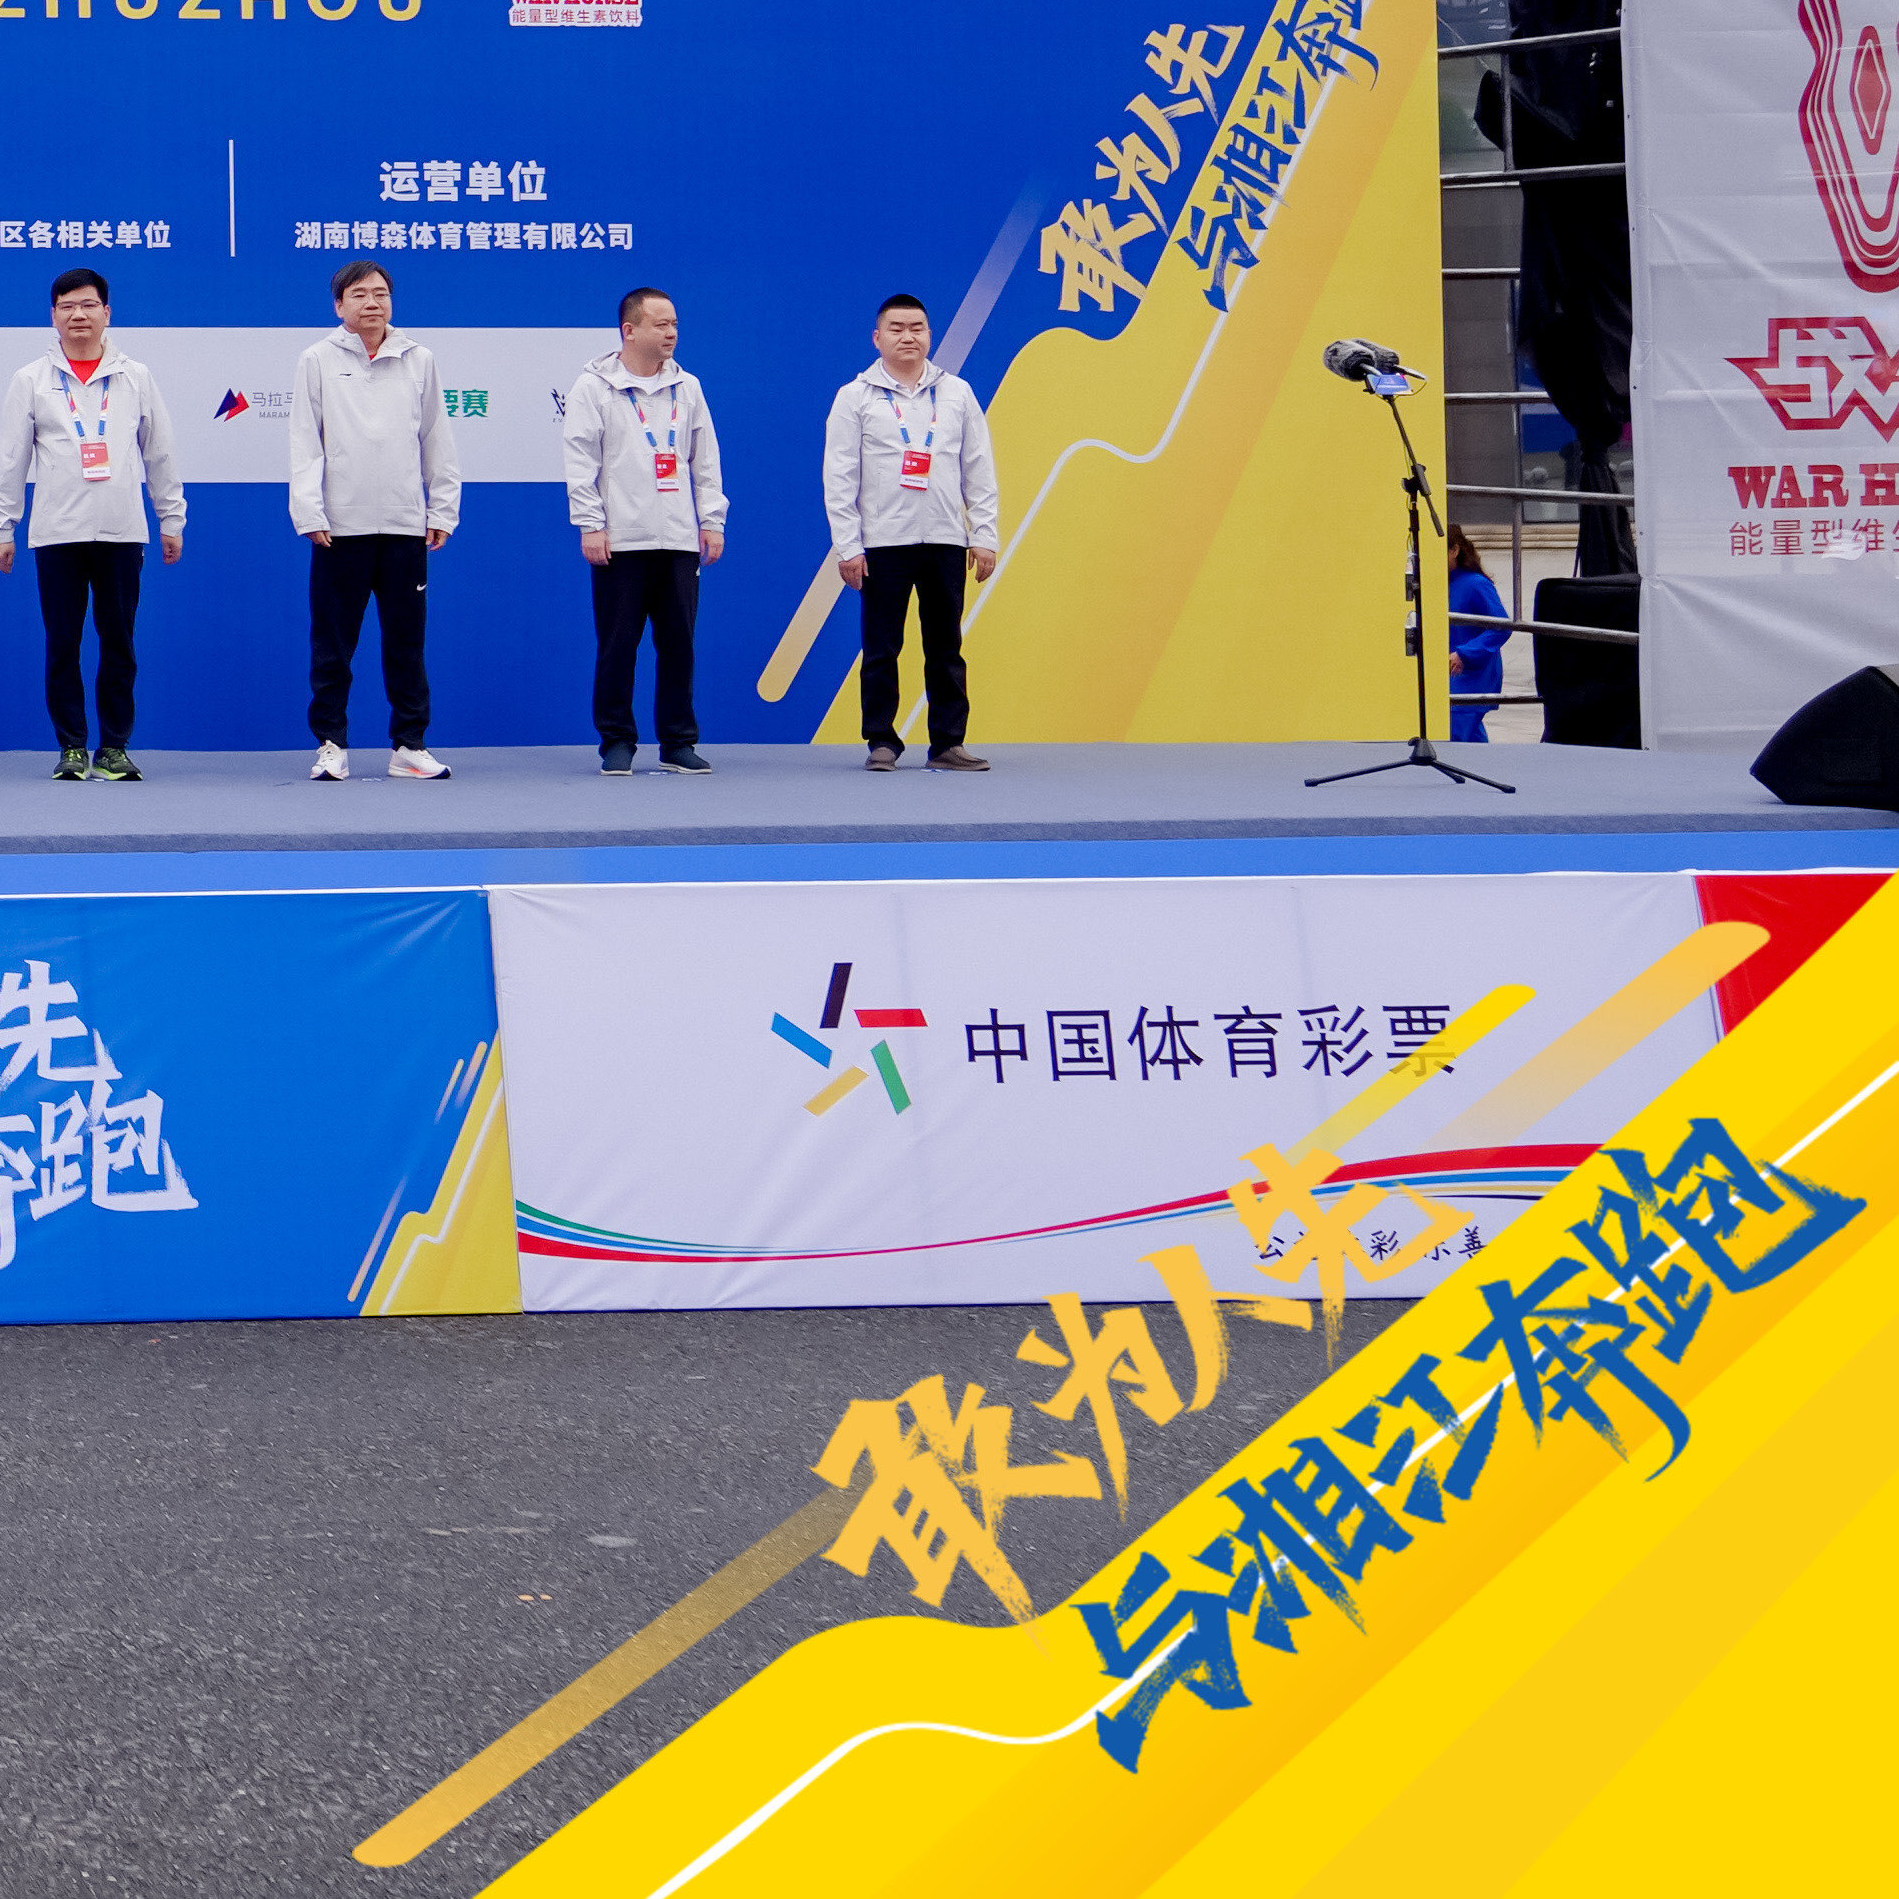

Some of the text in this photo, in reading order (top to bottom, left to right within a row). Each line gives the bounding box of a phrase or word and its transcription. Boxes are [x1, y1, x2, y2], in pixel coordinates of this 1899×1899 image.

[511, 8, 640, 24] 能量型维生素饮料
[379, 159, 548, 203] 运营单位
[1038, 23, 1245, 313] 敢为人先
[293, 220, 634, 251] 湖南博森体育管理有限公司
[1727, 464, 1849, 509] WAR
[1729, 519, 1899, 557] 能量型维
[963, 1001, 1459, 1085] 中国体育彩票
